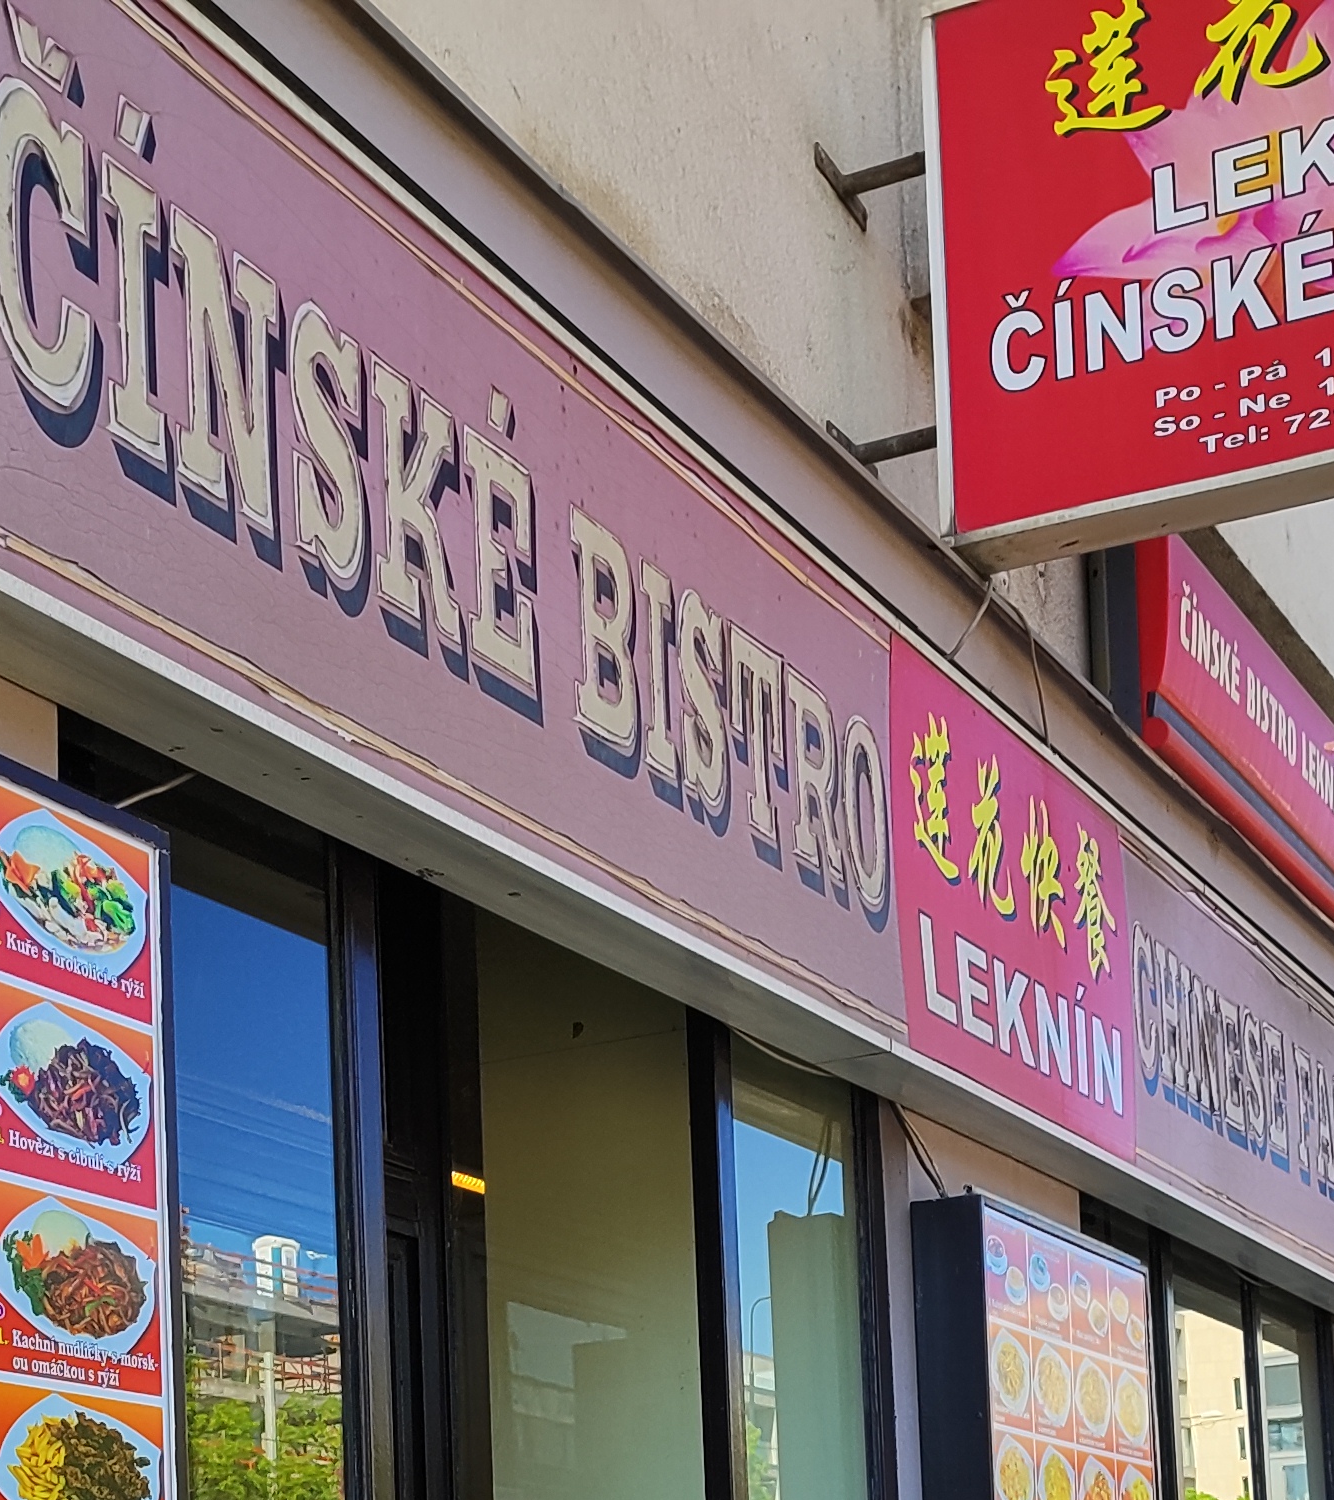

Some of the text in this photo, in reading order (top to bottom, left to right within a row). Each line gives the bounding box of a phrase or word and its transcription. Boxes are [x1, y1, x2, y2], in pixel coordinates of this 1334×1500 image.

[1155, 385, 1202, 408] Po
[1239, 360, 1287, 388] Pá
[1153, 414, 1200, 437] So
[1239, 391, 1292, 418] Ne
[1199, 425, 1269, 454] Tel:
[1180, 580, 1241, 705] ČÍNSKÉ
[1246, 666, 1296, 766] BISTRO
[571, 507, 891, 932] BISTRO
[6, 931, 39, 959] Kuře
[42, 950, 49, 962] s
[53, 949, 108, 984] brokolicí
[110, 975, 117, 989] s
[121, 978, 145, 998] rýží
[918, 910, 1123, 1117] LEKNÍN
[1132, 921, 1289, 1173] CHINESE
[58, 1149, 66, 1160] s
[107, 1160, 115, 1175] s
[118, 1162, 141, 1183] rýží
[12, 1329, 55, 1354] Kachní
[58, 1340, 106, 1366] nudličky
[111, 1352, 117, 1365] s
[13, 1356, 120, 1388] ou omáčkou s rýží
